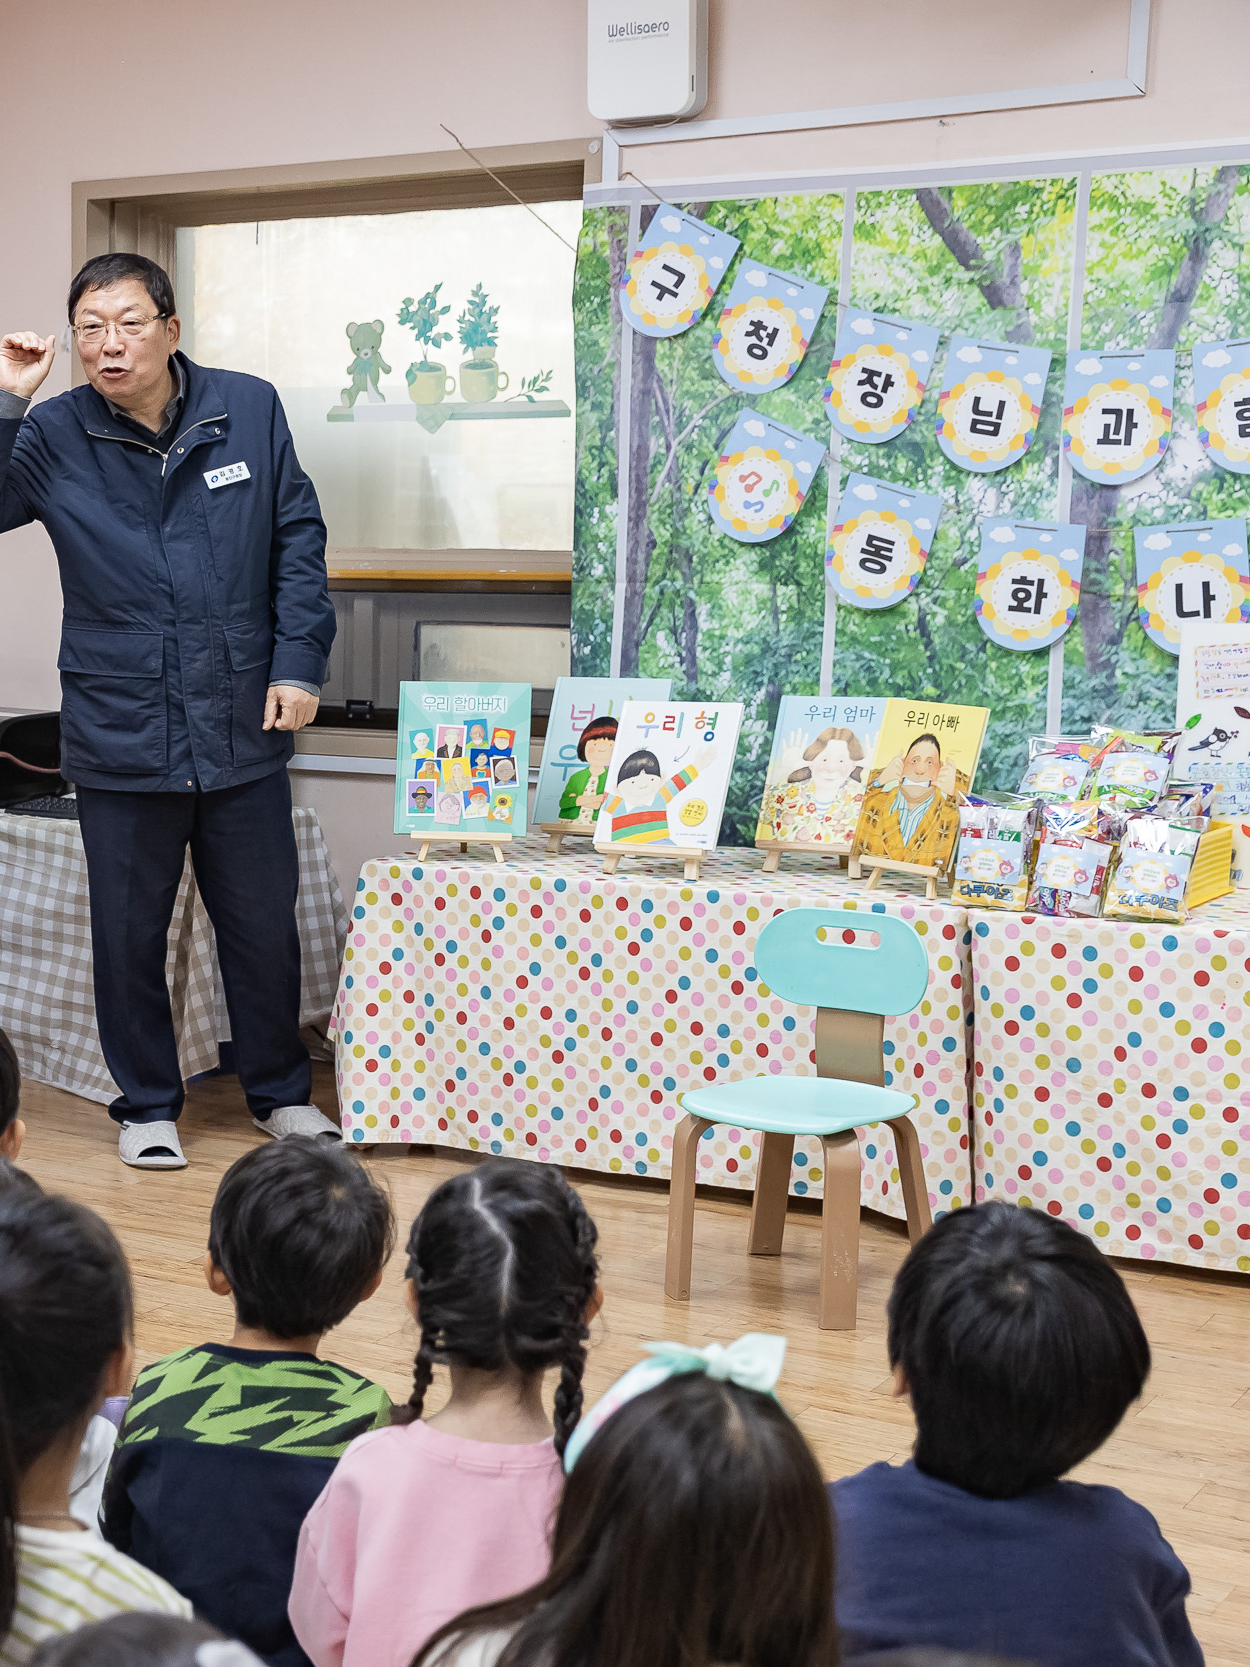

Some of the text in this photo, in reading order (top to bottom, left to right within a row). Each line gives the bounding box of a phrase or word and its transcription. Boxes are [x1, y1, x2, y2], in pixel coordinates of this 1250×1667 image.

[607, 21, 670, 38] Wellisaero
[423, 696, 507, 712] 우리 할아버지
[804, 704, 877, 724] 우리 엄마
[570, 703, 596, 732] 넌
[636, 710, 719, 742] 우리 형
[903, 710, 961, 733] 우리 아빠
[960, 884, 1014, 902] 다쿠아즈
